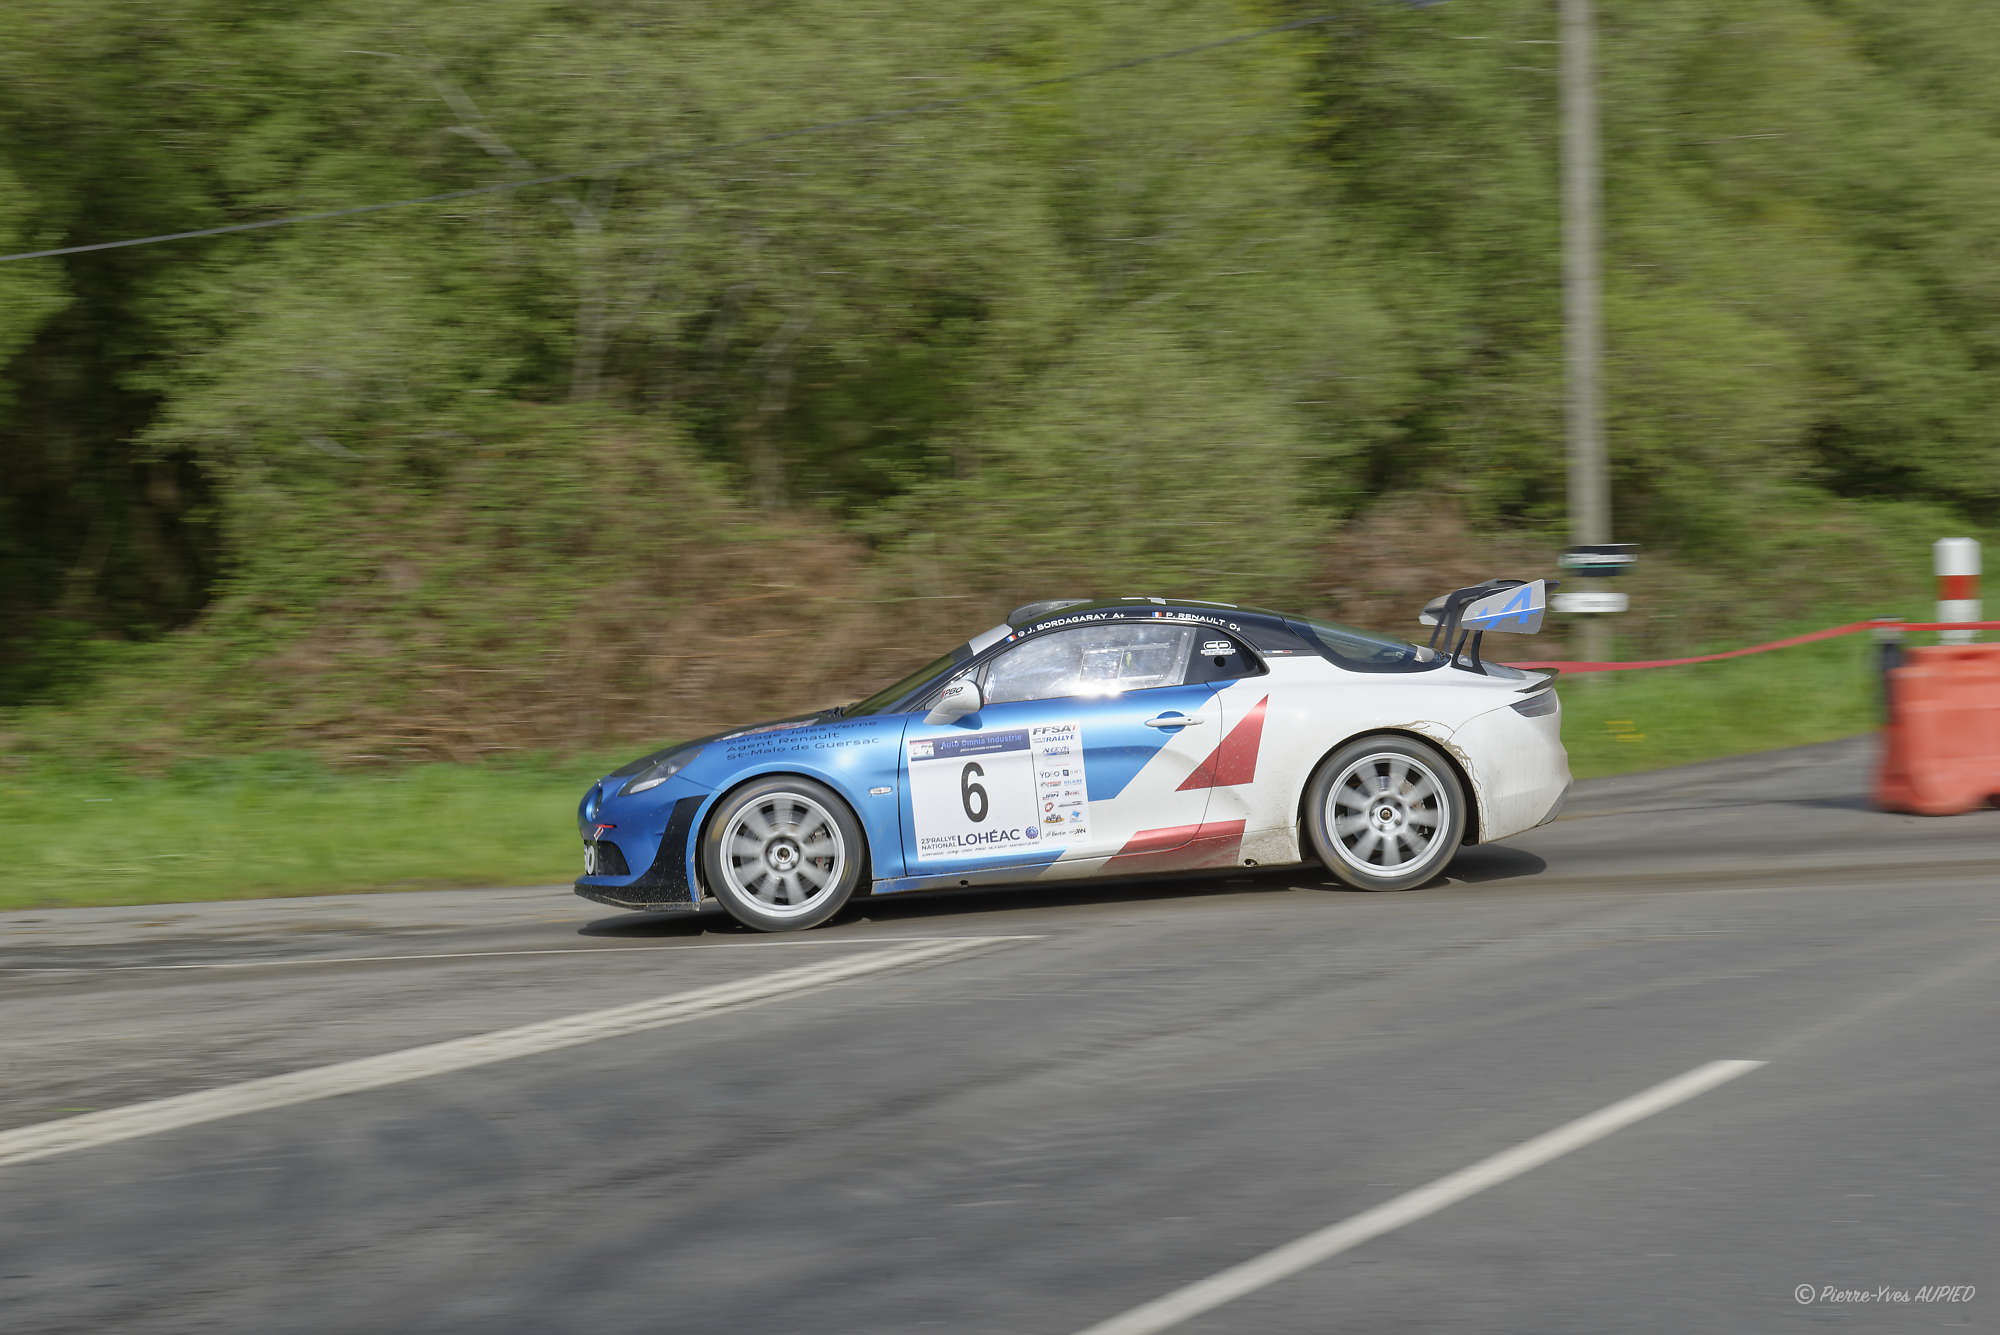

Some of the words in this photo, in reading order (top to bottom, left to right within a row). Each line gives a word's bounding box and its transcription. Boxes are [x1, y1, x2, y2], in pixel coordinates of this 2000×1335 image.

[1037, 613, 1107, 631] BORDAGARAY
[1178, 613, 1226, 626] RENAULT
[1033, 725, 1071, 735] FFSA
[778, 733, 841, 744] Renault
[814, 737, 880, 749] Guersac
[961, 761, 988, 822] 6
[931, 835, 957, 843] RALLYE
[958, 829, 1021, 847] LOHÉAC
[921, 842, 957, 851] NATIONAL
